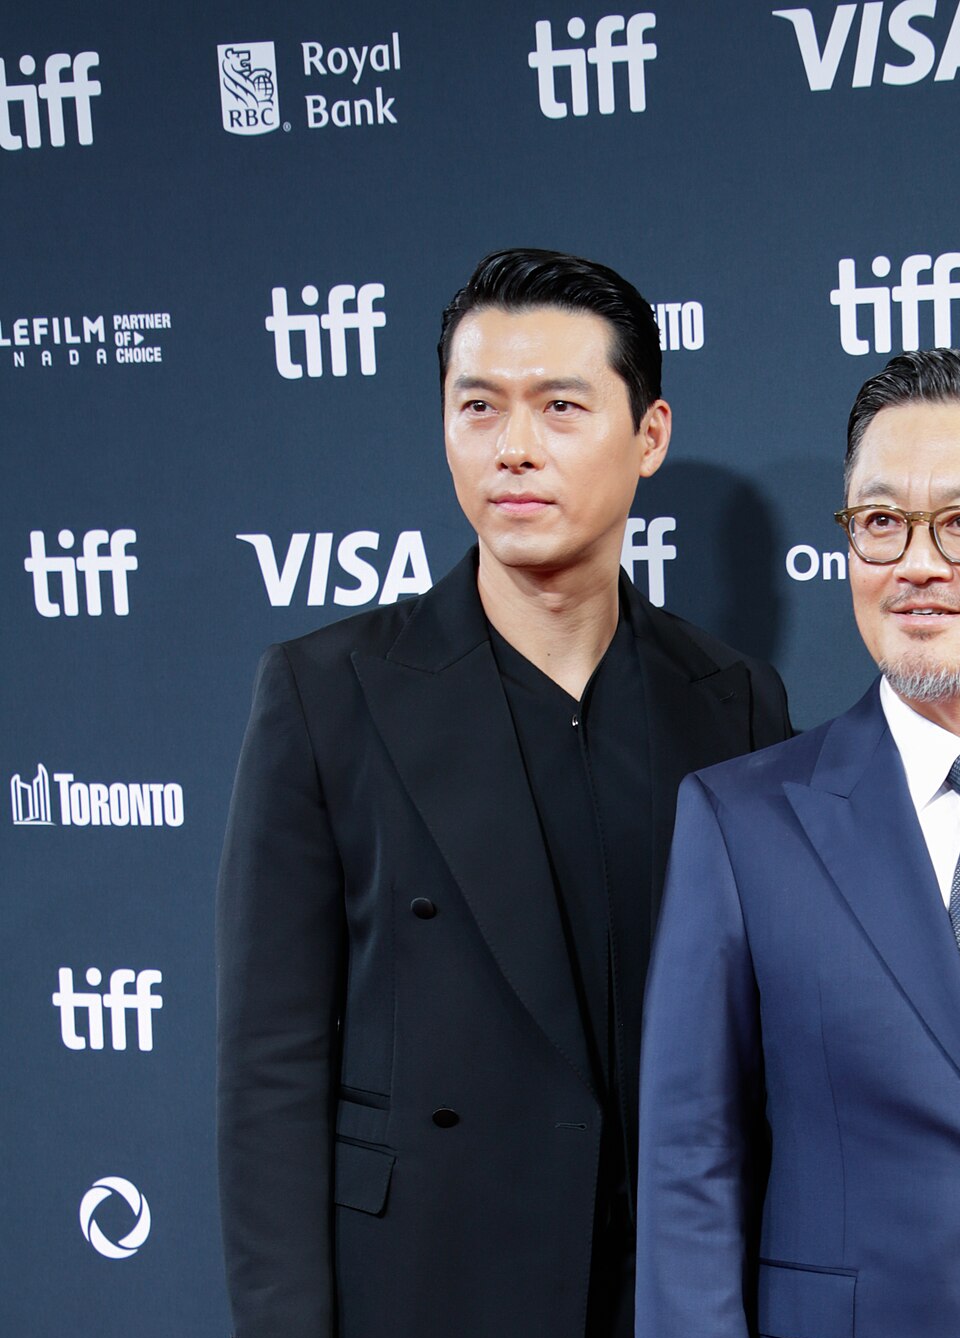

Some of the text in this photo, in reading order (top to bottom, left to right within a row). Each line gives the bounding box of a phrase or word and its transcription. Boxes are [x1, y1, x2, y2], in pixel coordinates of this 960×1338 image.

[301, 31, 401, 85] Royal
[527, 12, 658, 119] tiff
[0, 51, 102, 151] tiff
[228, 107, 275, 129] RBC
[304, 86, 398, 129] Bank
[113, 313, 172, 331] PARTNER
[114, 331, 132, 347] OF
[264, 282, 387, 380] tiff
[115, 346, 163, 364] CHOICE
[23, 528, 139, 618] tiff
[235, 530, 434, 607] VISA
[785, 544, 848, 581] On
[54, 772, 185, 828] TORONTO
[52, 967, 164, 1052] tiff
